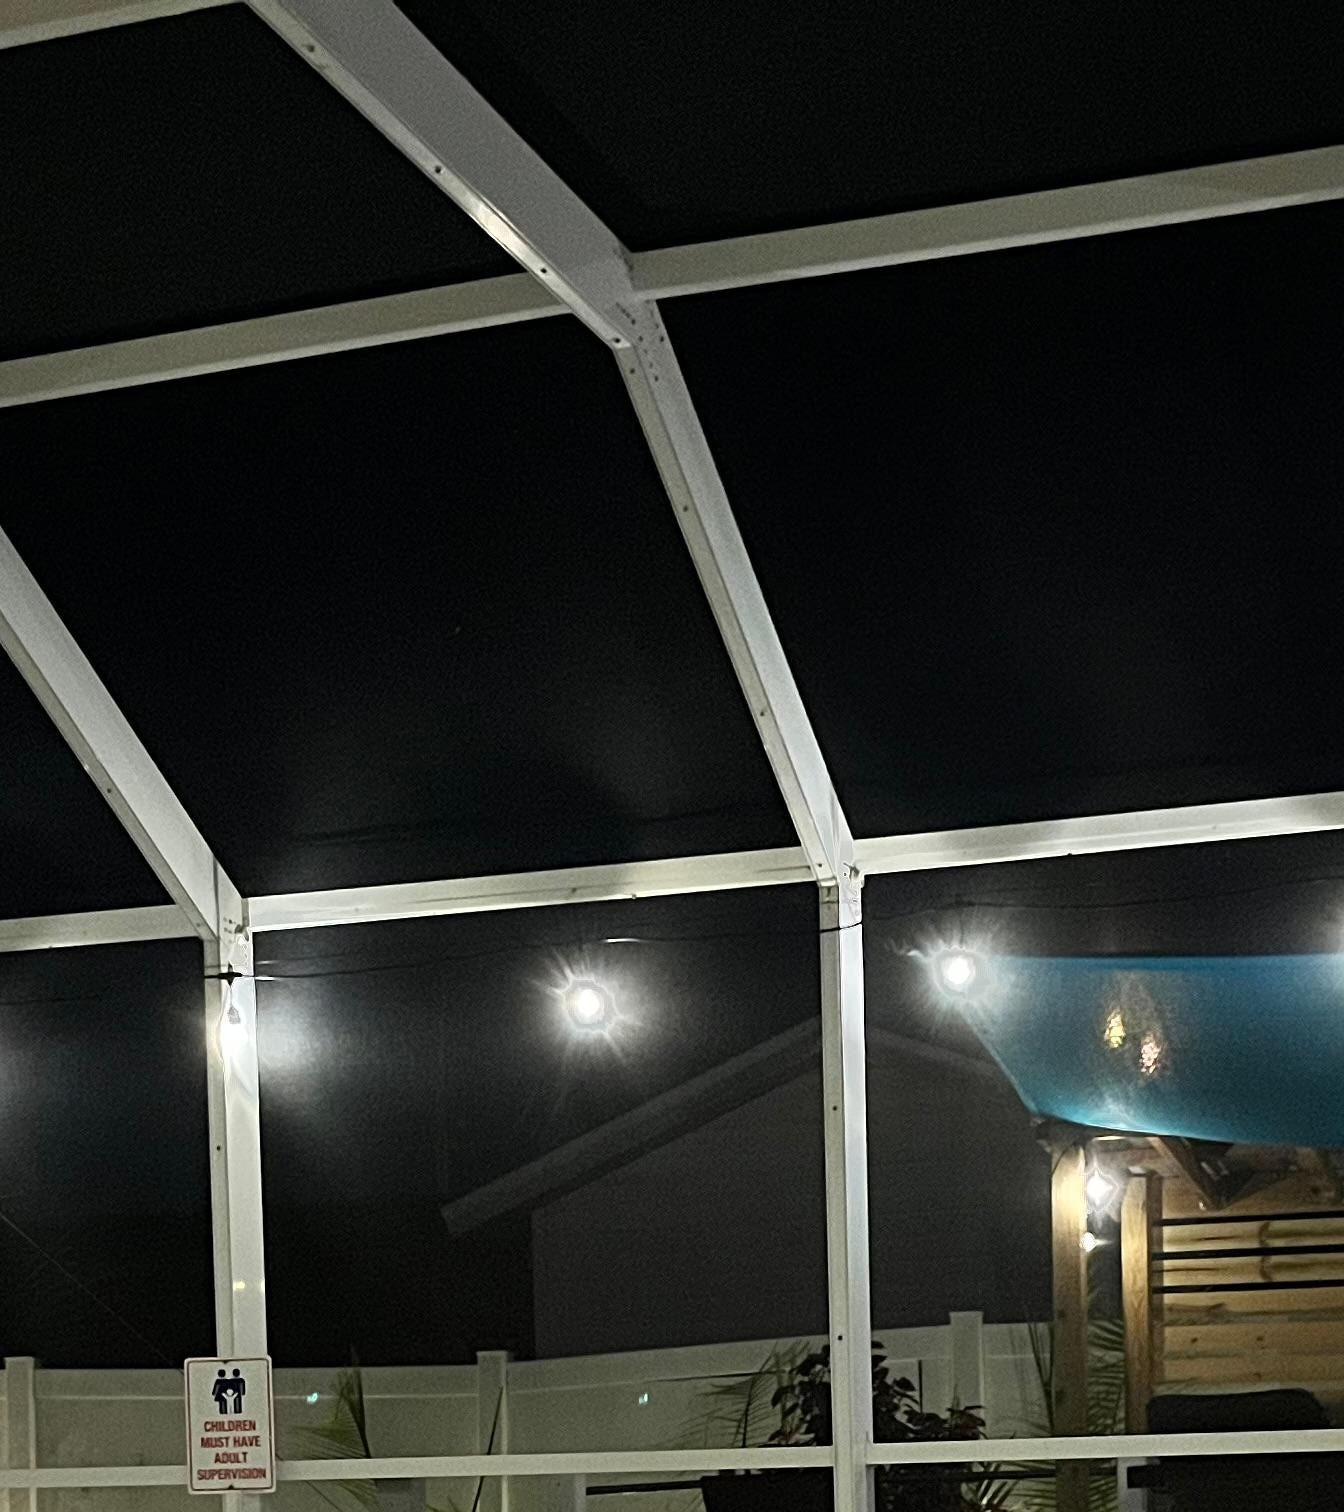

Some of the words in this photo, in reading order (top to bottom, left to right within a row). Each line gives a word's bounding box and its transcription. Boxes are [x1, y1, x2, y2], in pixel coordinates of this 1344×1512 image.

[204, 1420, 256, 1432] CHILDREN
[200, 1437, 229, 1448] MUST
[233, 1435, 261, 1447] HAVE
[214, 1452, 248, 1463] ADULT
[197, 1468, 266, 1480] SUPERVISION
